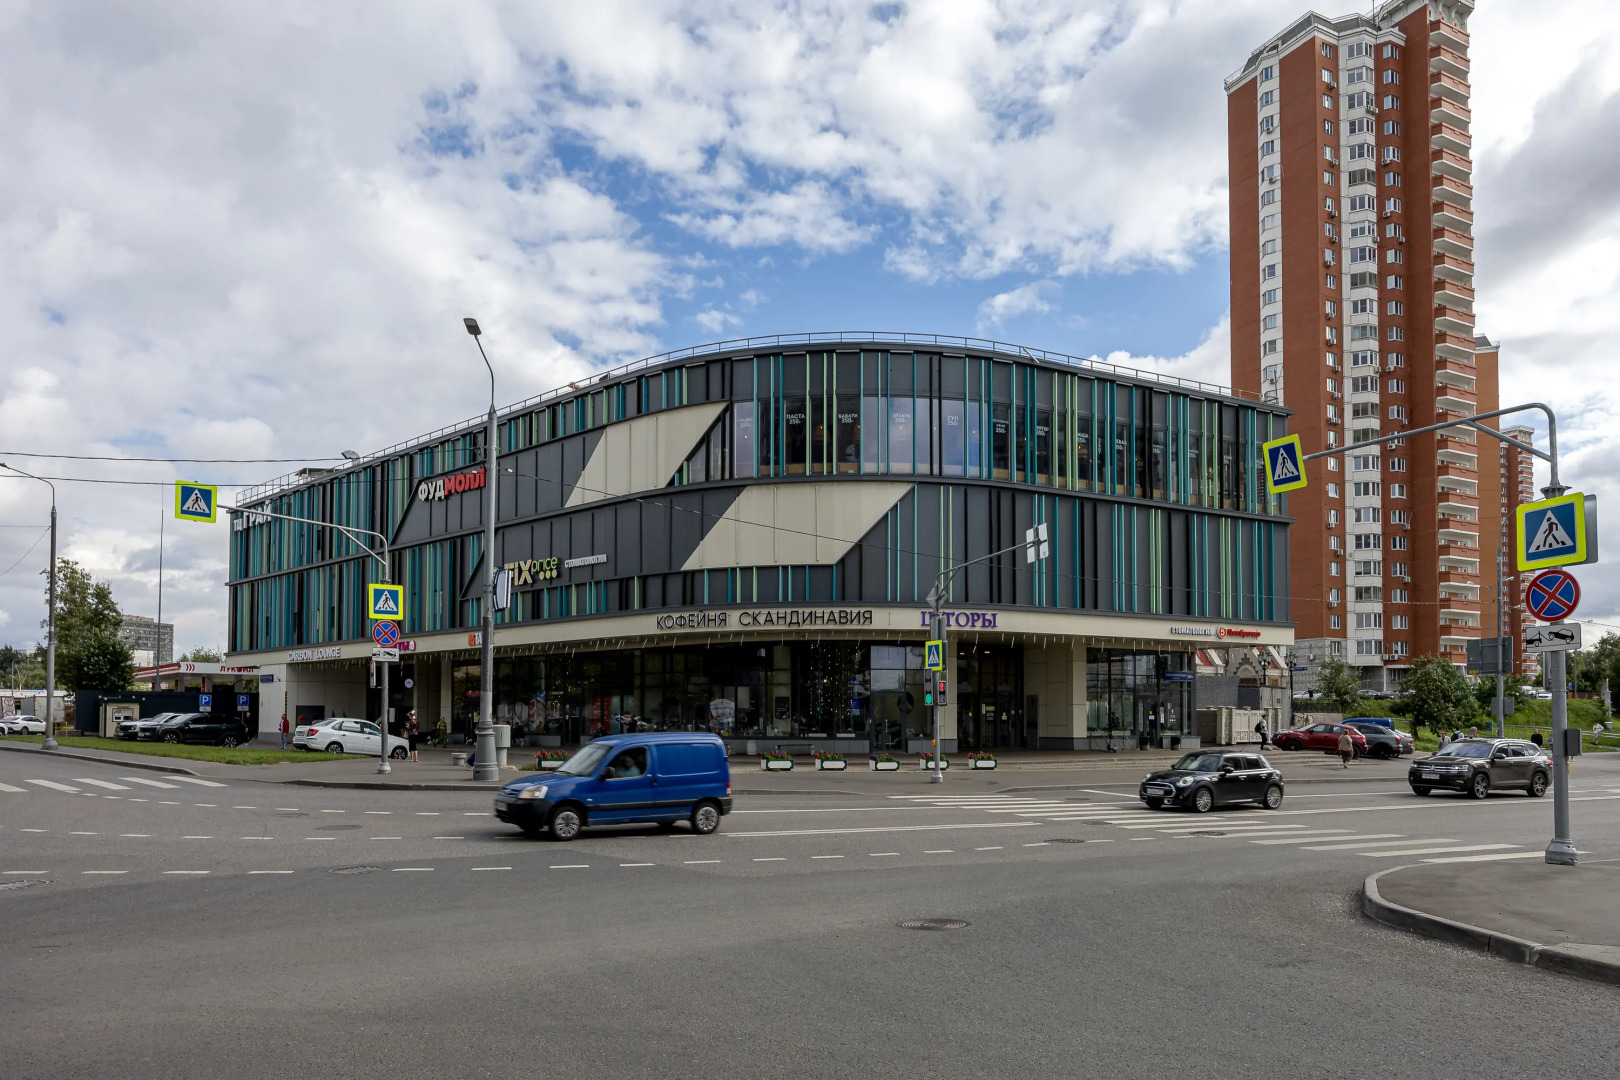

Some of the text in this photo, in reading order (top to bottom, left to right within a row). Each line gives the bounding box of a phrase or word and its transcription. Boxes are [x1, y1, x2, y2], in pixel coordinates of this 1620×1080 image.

[418, 467, 485, 502] ФУДМОЛЛ
[564, 553, 607, 568] СТОМАТОЛОГИЯ
[656, 610, 872, 630] КОФЕЙНЯ СКАНДИНАВИЯ
[288, 647, 341, 661] CARBON LOUNGE
